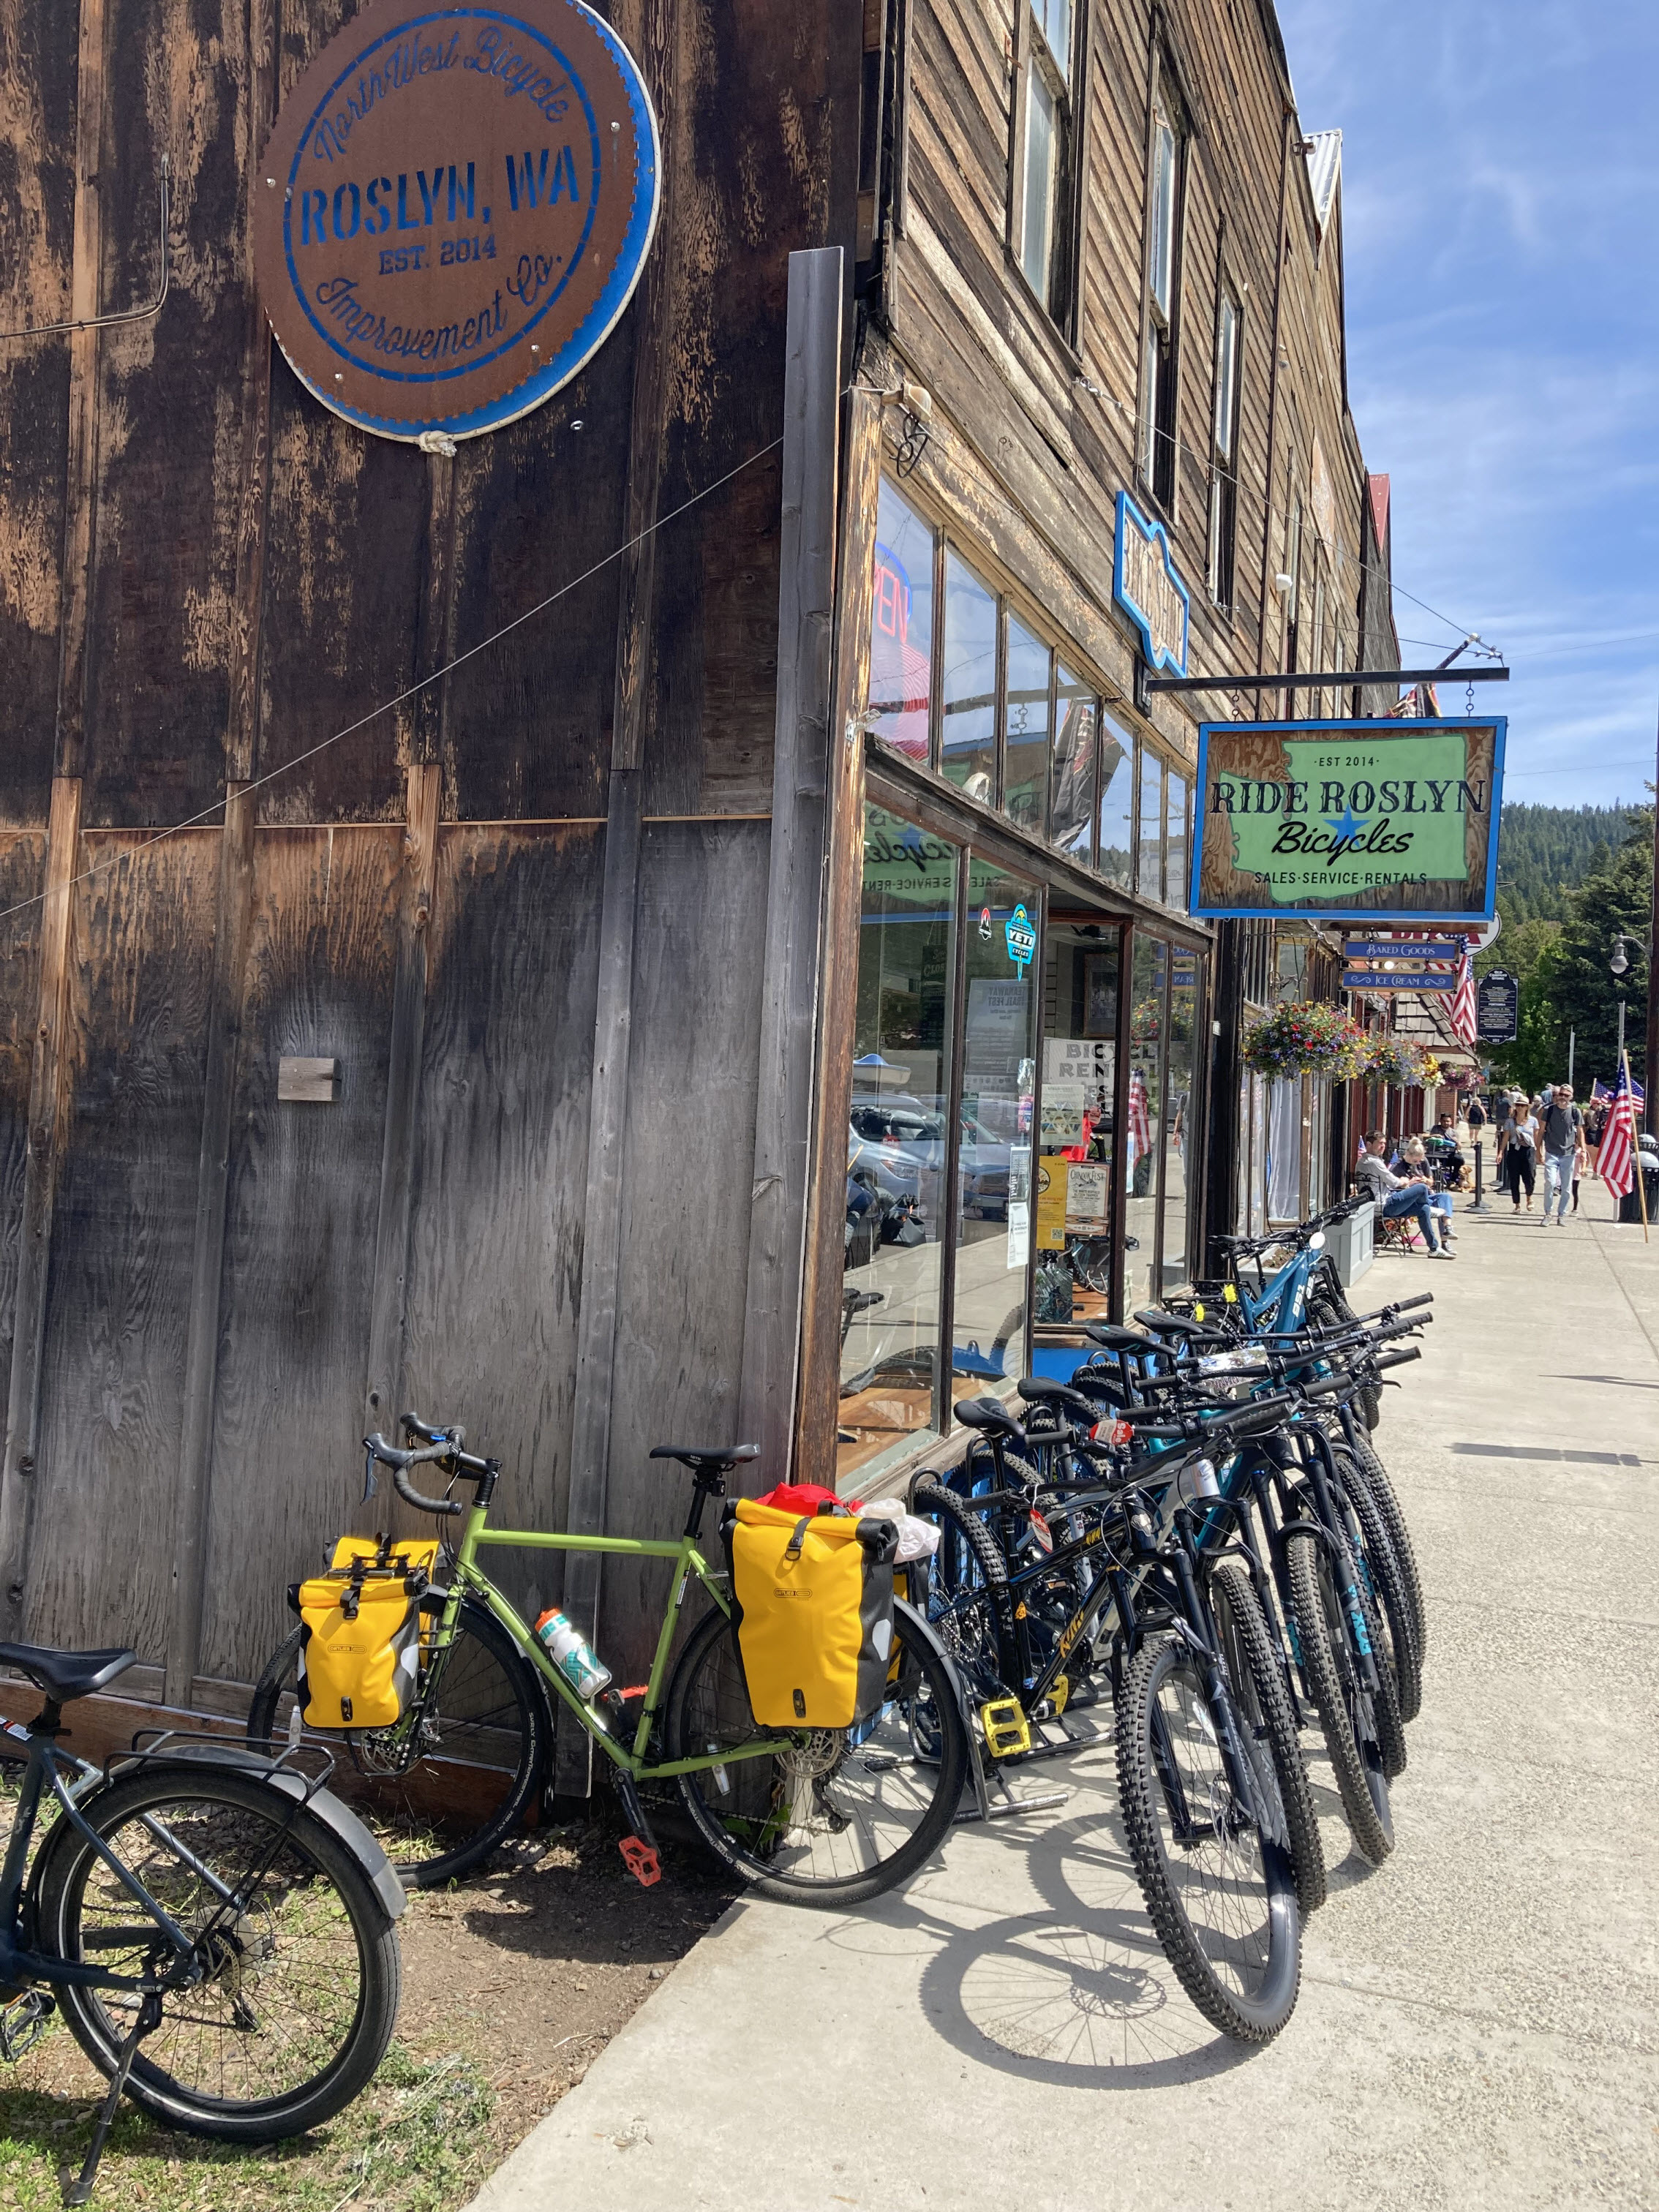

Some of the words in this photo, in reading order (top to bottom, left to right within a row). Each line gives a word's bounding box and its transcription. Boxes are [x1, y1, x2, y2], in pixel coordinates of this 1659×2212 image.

[464, 26, 569, 123] Bicycle
[301, 162, 492, 246] ROSLYN,
[506, 145, 580, 211] WA
[378, 245, 431, 275] EST.
[440, 234, 497, 266] 2014
[316, 277, 508, 361] Improvement
[507, 254, 563, 306] Co.
[1156, 568, 1184, 661] SHOP
[1319, 756, 1340, 767] EST
[1345, 756, 1375, 767] 2014
[1210, 781, 1309, 813] RIDE
[1318, 780, 1486, 813] ROSLYN
[1272, 818, 1415, 866] Bicycles
[1009, 930, 1034, 946] YETI
[1366, 944, 1399, 956] BAKED
[1400, 944, 1436, 956] GOODS
[1012, 947, 1029, 958] CYCLES
[1375, 975, 1389, 985] ICE
[1391, 975, 1420, 986] CREAM
[1115, 1422, 1126, 1442] Sale
[734, 1865, 758, 1881] SURLY
